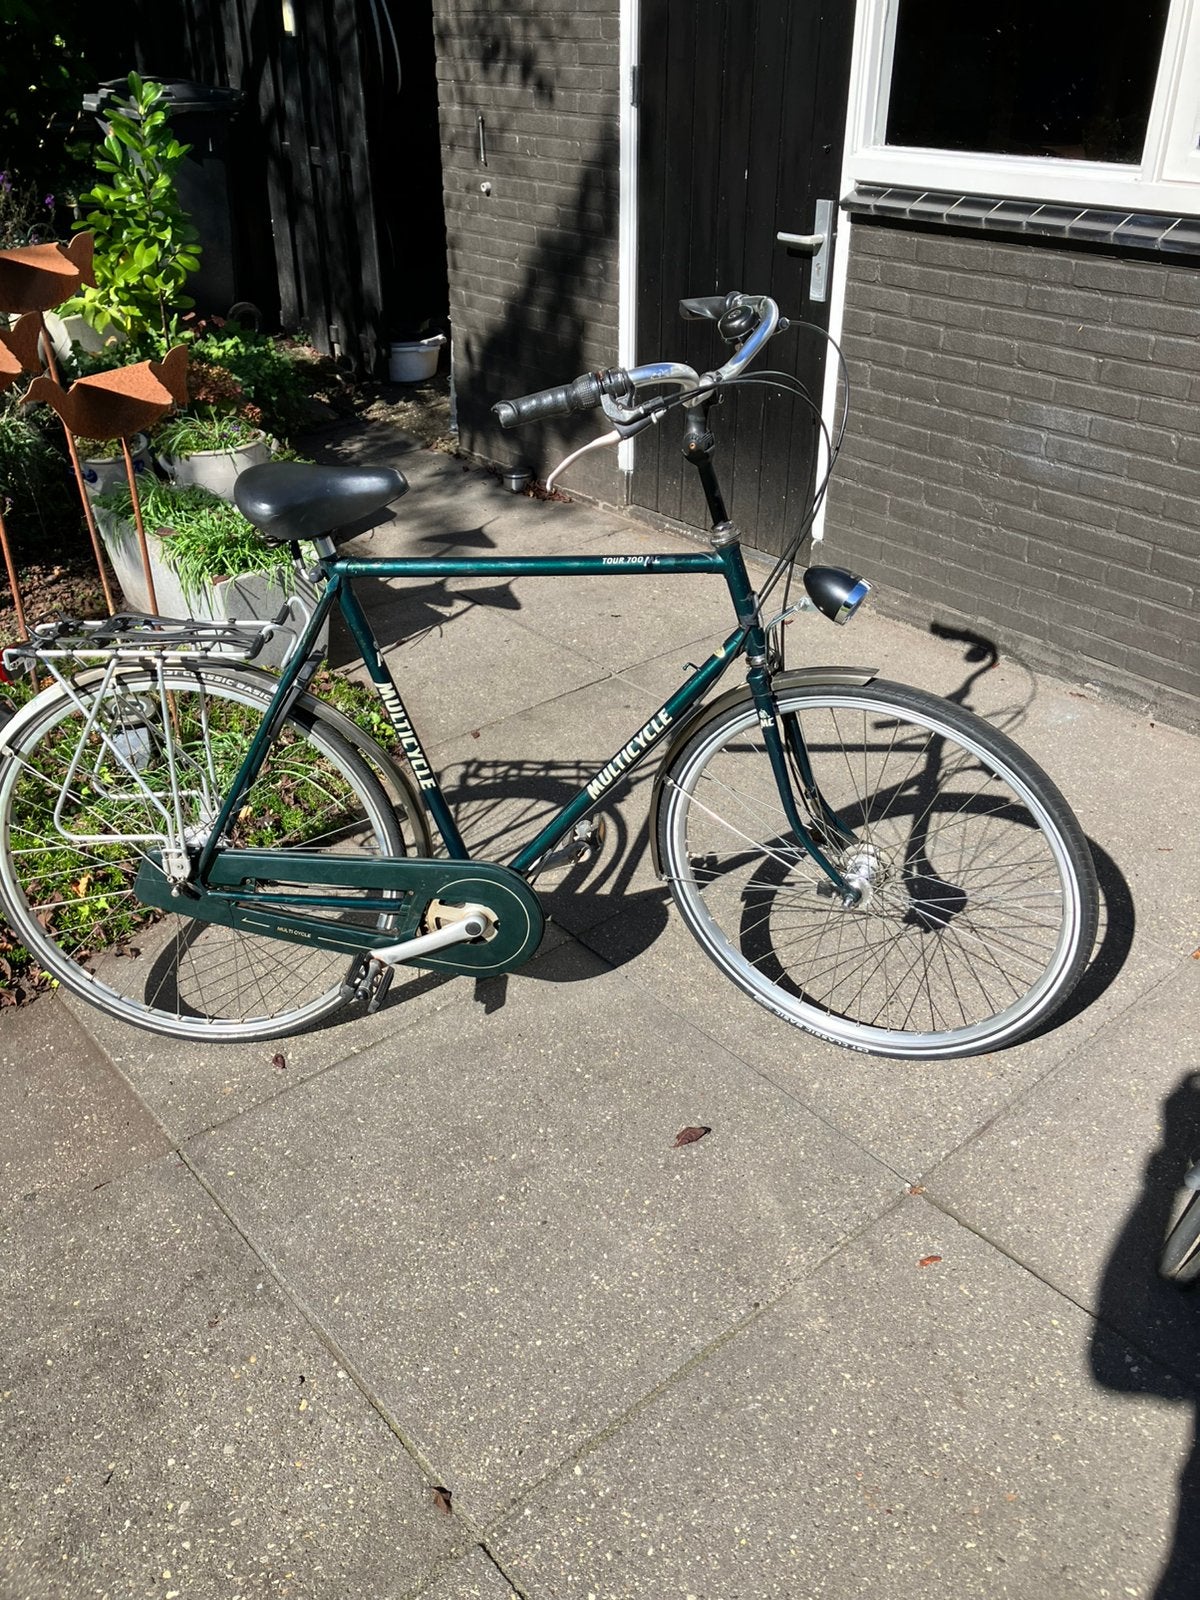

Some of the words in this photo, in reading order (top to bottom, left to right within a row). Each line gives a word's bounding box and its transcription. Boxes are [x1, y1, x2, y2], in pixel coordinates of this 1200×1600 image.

[602, 557, 625, 565] TOUR
[626, 556, 644, 564] 700
[183, 670, 235, 686] CLASSIC
[236, 683, 272, 701] BASIC
[374, 682, 437, 791] MULTICYCLE
[586, 708, 673, 800] MULTICYCLE
[803, 1025, 849, 1047] CLASSIC
